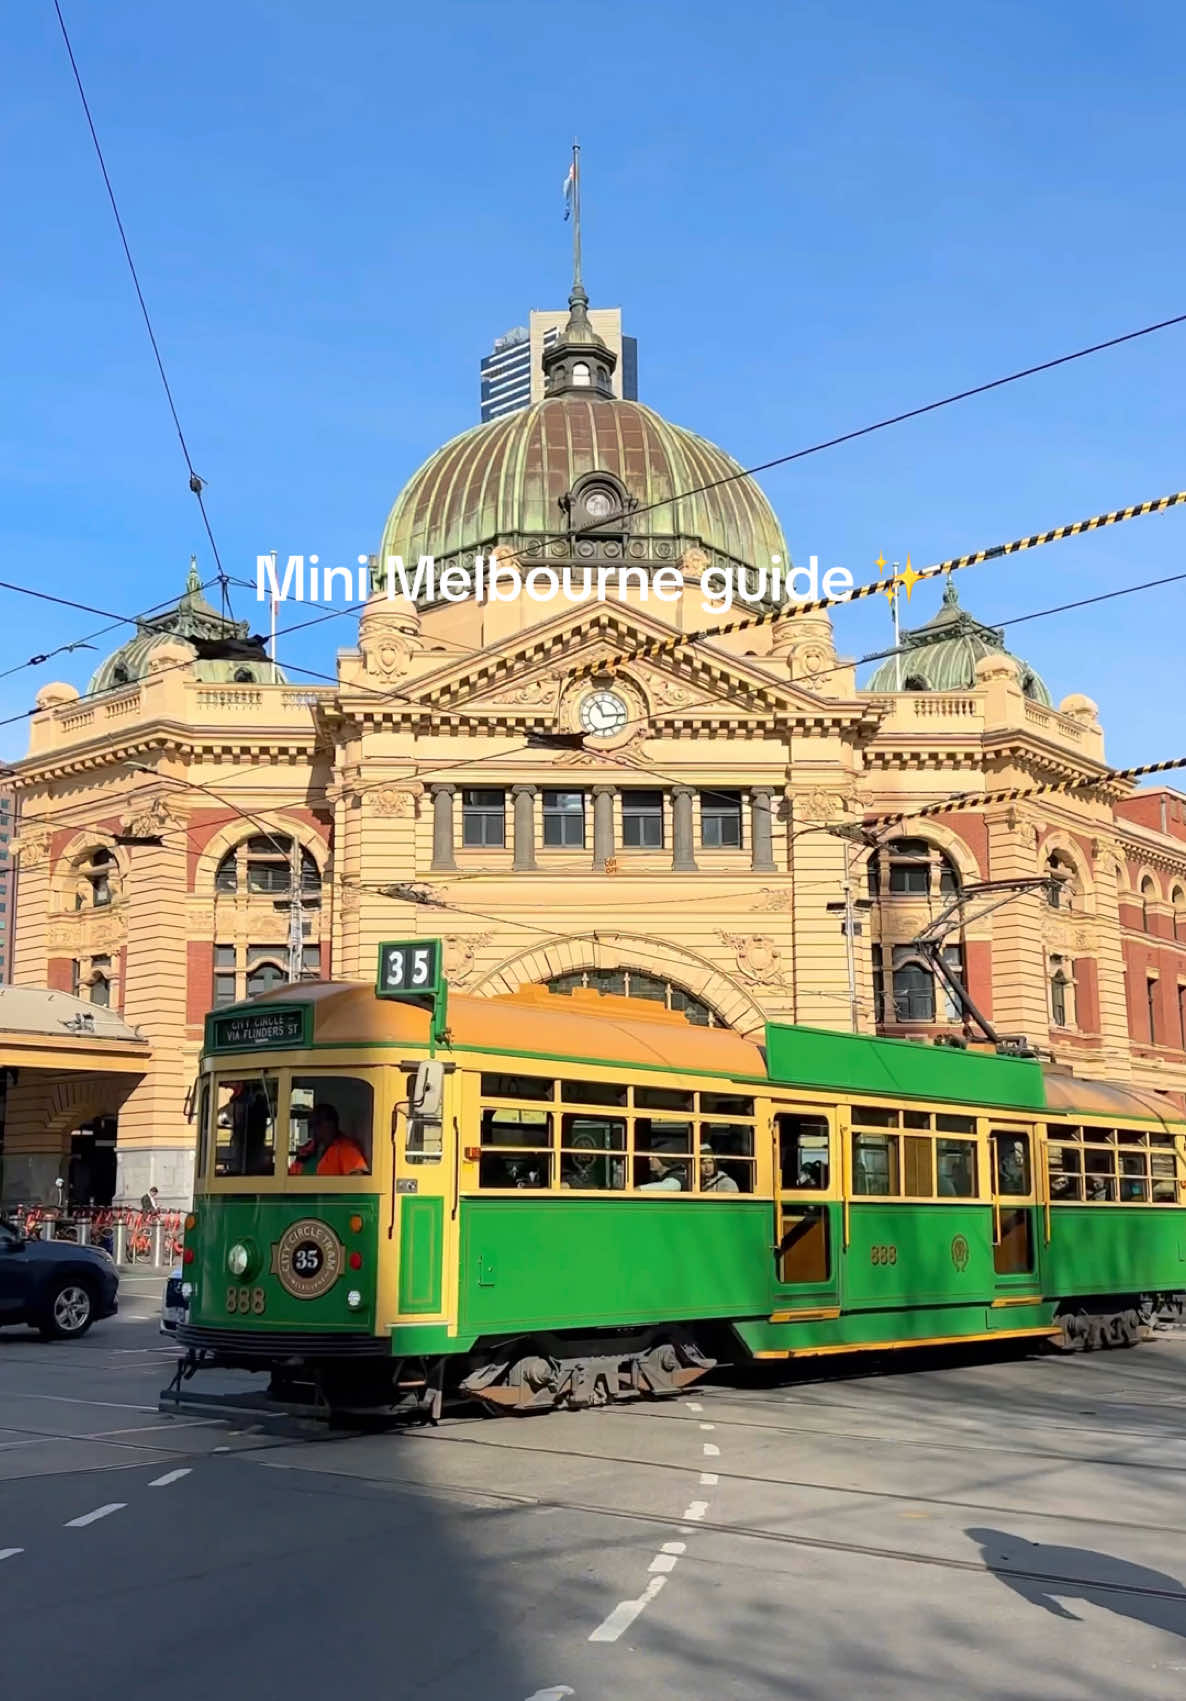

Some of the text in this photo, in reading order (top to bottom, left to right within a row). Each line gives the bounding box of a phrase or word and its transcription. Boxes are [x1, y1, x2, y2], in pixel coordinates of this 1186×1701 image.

[386, 950, 429, 986] 35
[226, 1023, 299, 1041] VIA FLINDERS ST
[281, 1226, 336, 1273] CITY CIRCLE TRAM
[295, 1249, 319, 1270] 35
[226, 1286, 265, 1314] 888
